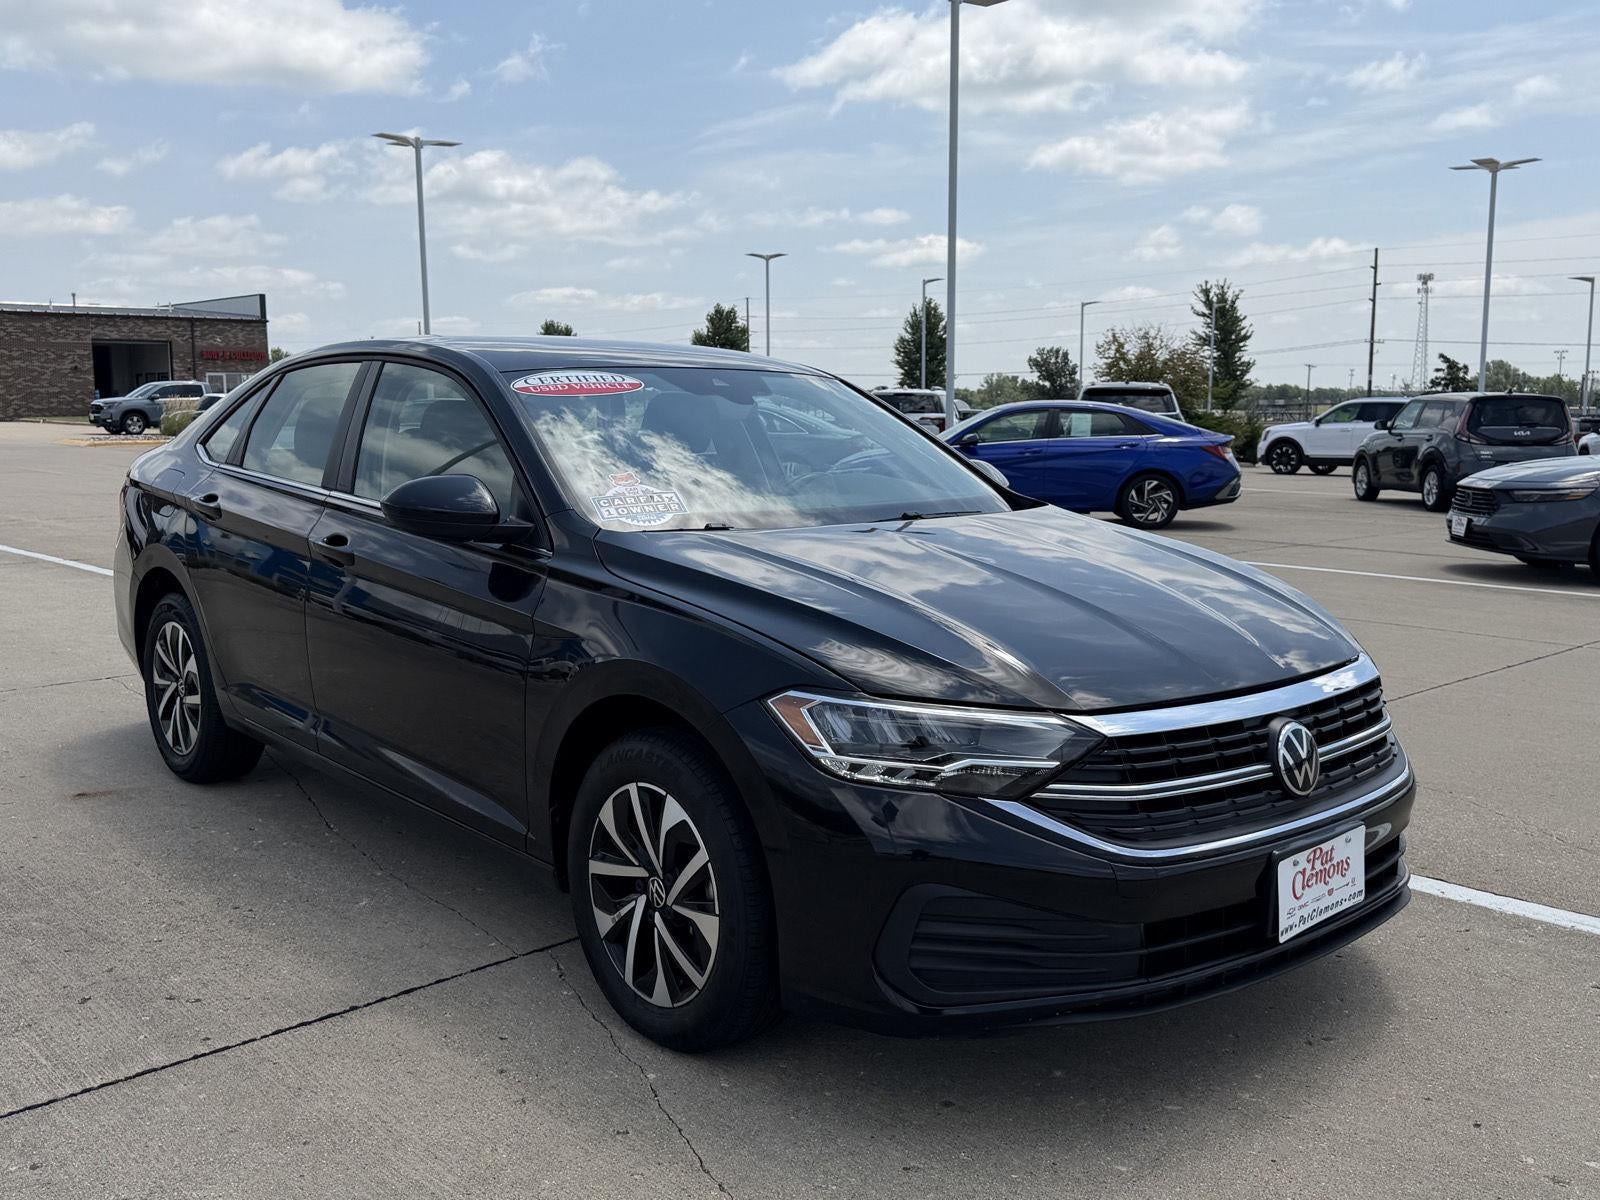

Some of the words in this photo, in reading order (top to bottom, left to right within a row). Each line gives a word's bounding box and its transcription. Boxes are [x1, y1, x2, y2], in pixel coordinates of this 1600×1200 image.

[524, 374, 626, 386] CERTIFIED
[529, 384, 568, 393] USED
[572, 383, 631, 391] VEHICLE
[600, 494, 675, 507] CARFAX
[618, 503, 680, 515] OWNER
[1306, 845, 1336, 871] Pat
[1292, 855, 1351, 901] Clemons
